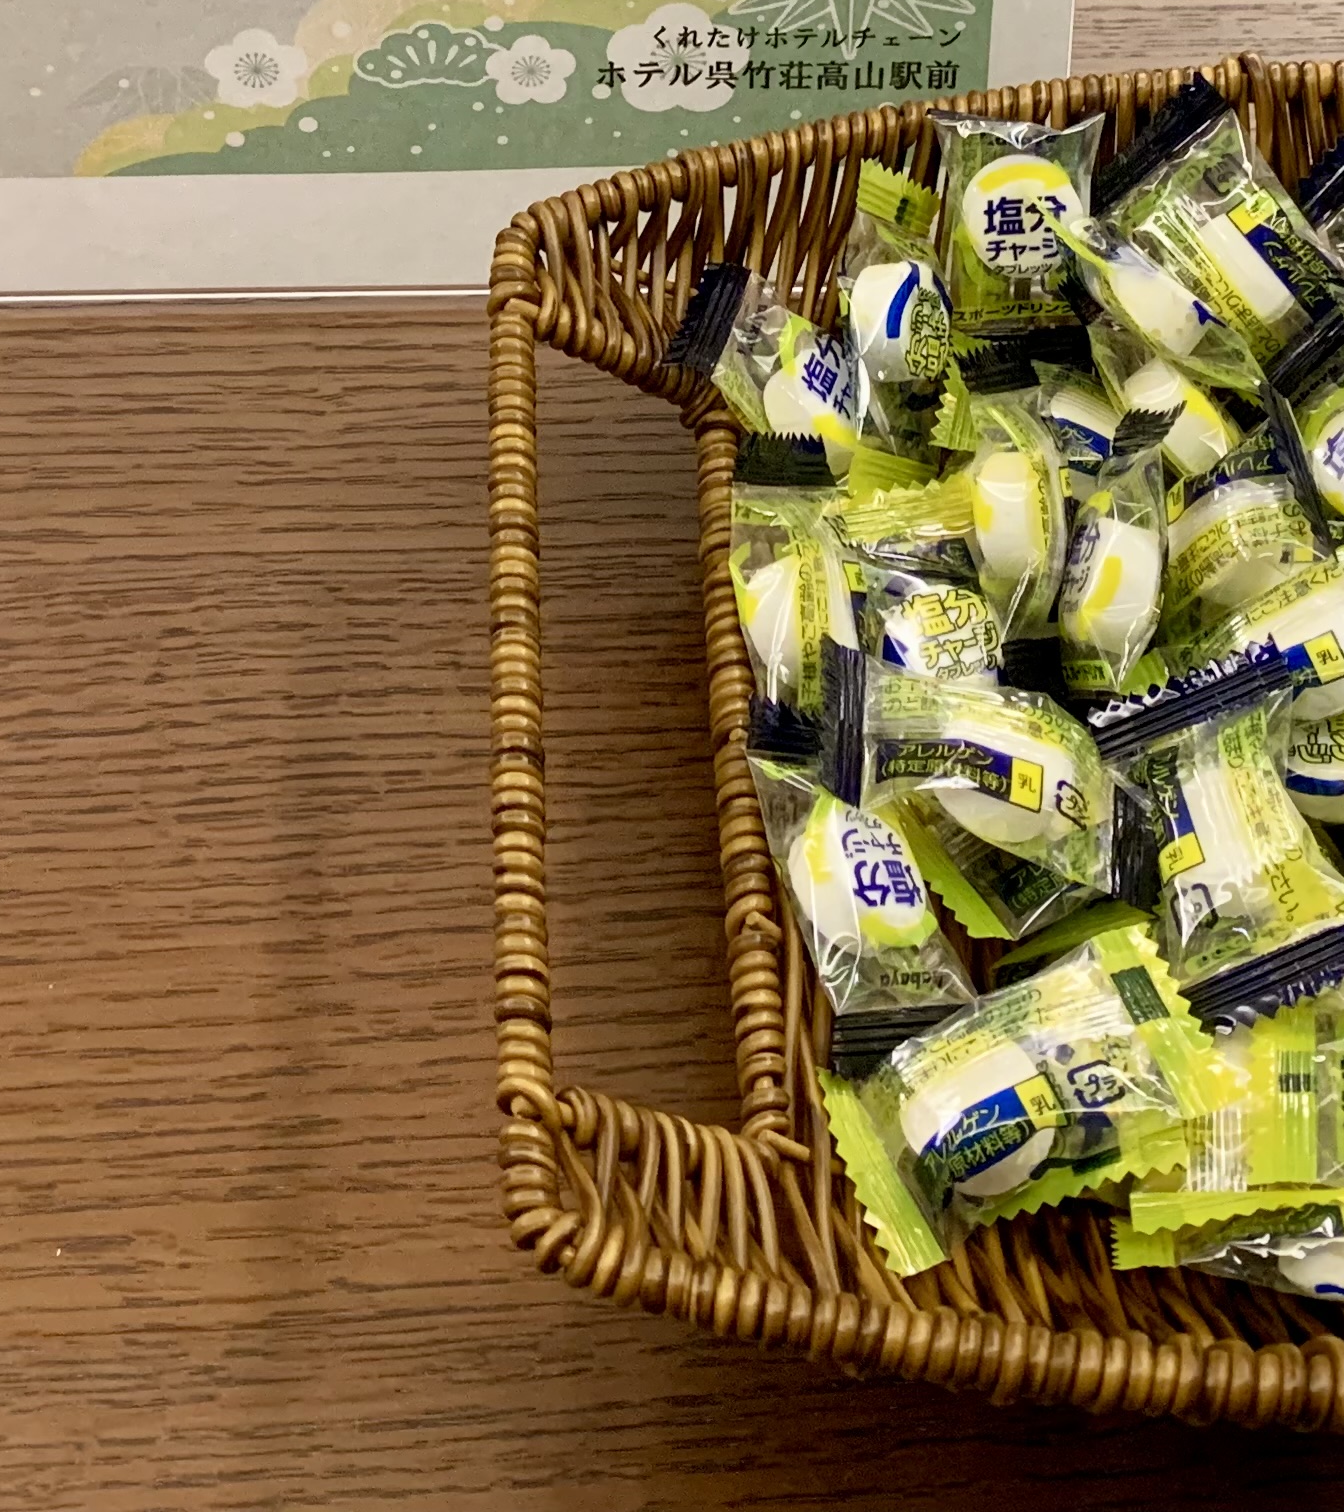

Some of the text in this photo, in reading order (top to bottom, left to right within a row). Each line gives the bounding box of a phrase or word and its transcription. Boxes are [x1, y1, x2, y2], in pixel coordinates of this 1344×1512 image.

[653, 27, 962, 50] くれたけホテルチェーン
[596, 59, 960, 90] ホテル呉竹荘高山駅前
[904, 587, 989, 638] 塩分
[853, 860, 924, 908] 塩分
